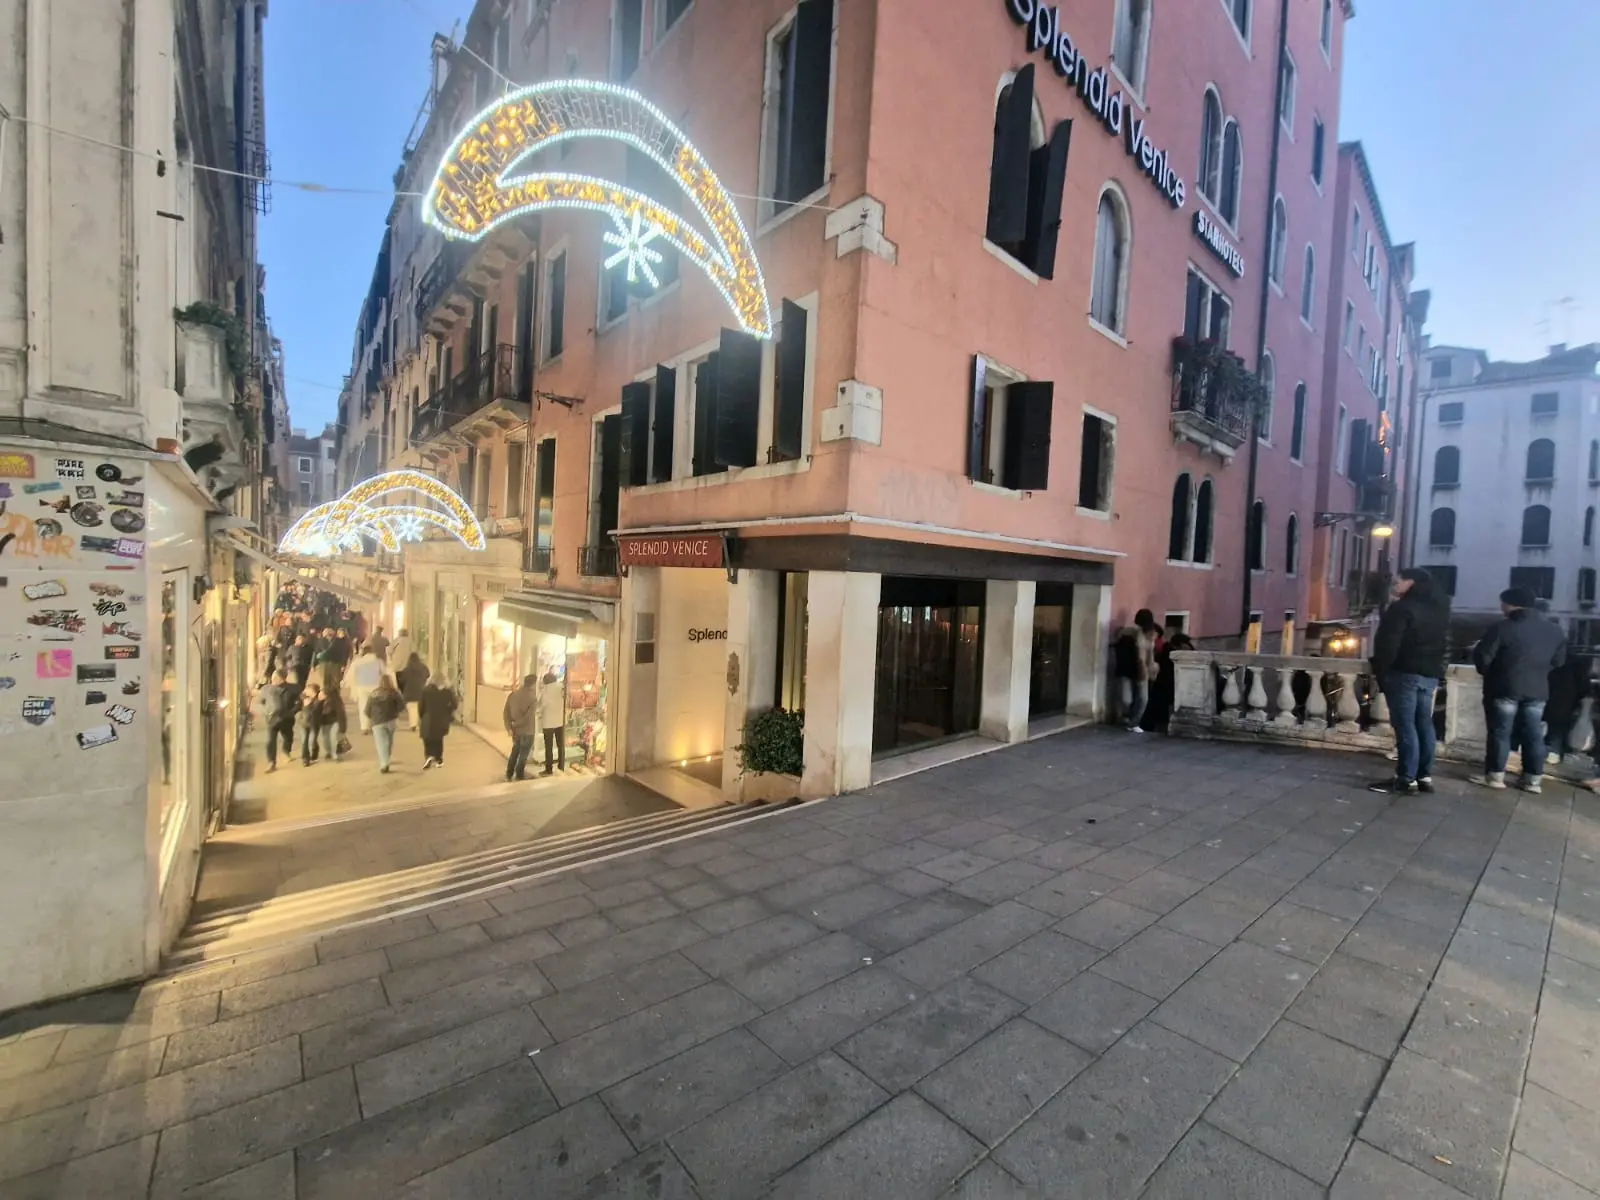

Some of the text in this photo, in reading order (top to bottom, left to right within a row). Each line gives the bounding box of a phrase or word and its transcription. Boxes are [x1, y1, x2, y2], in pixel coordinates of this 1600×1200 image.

[1127, 105, 1186, 208] Venice
[1198, 209, 1244, 278] STARHOTELS
[628, 540, 709, 556] SPLENDID VENICE
